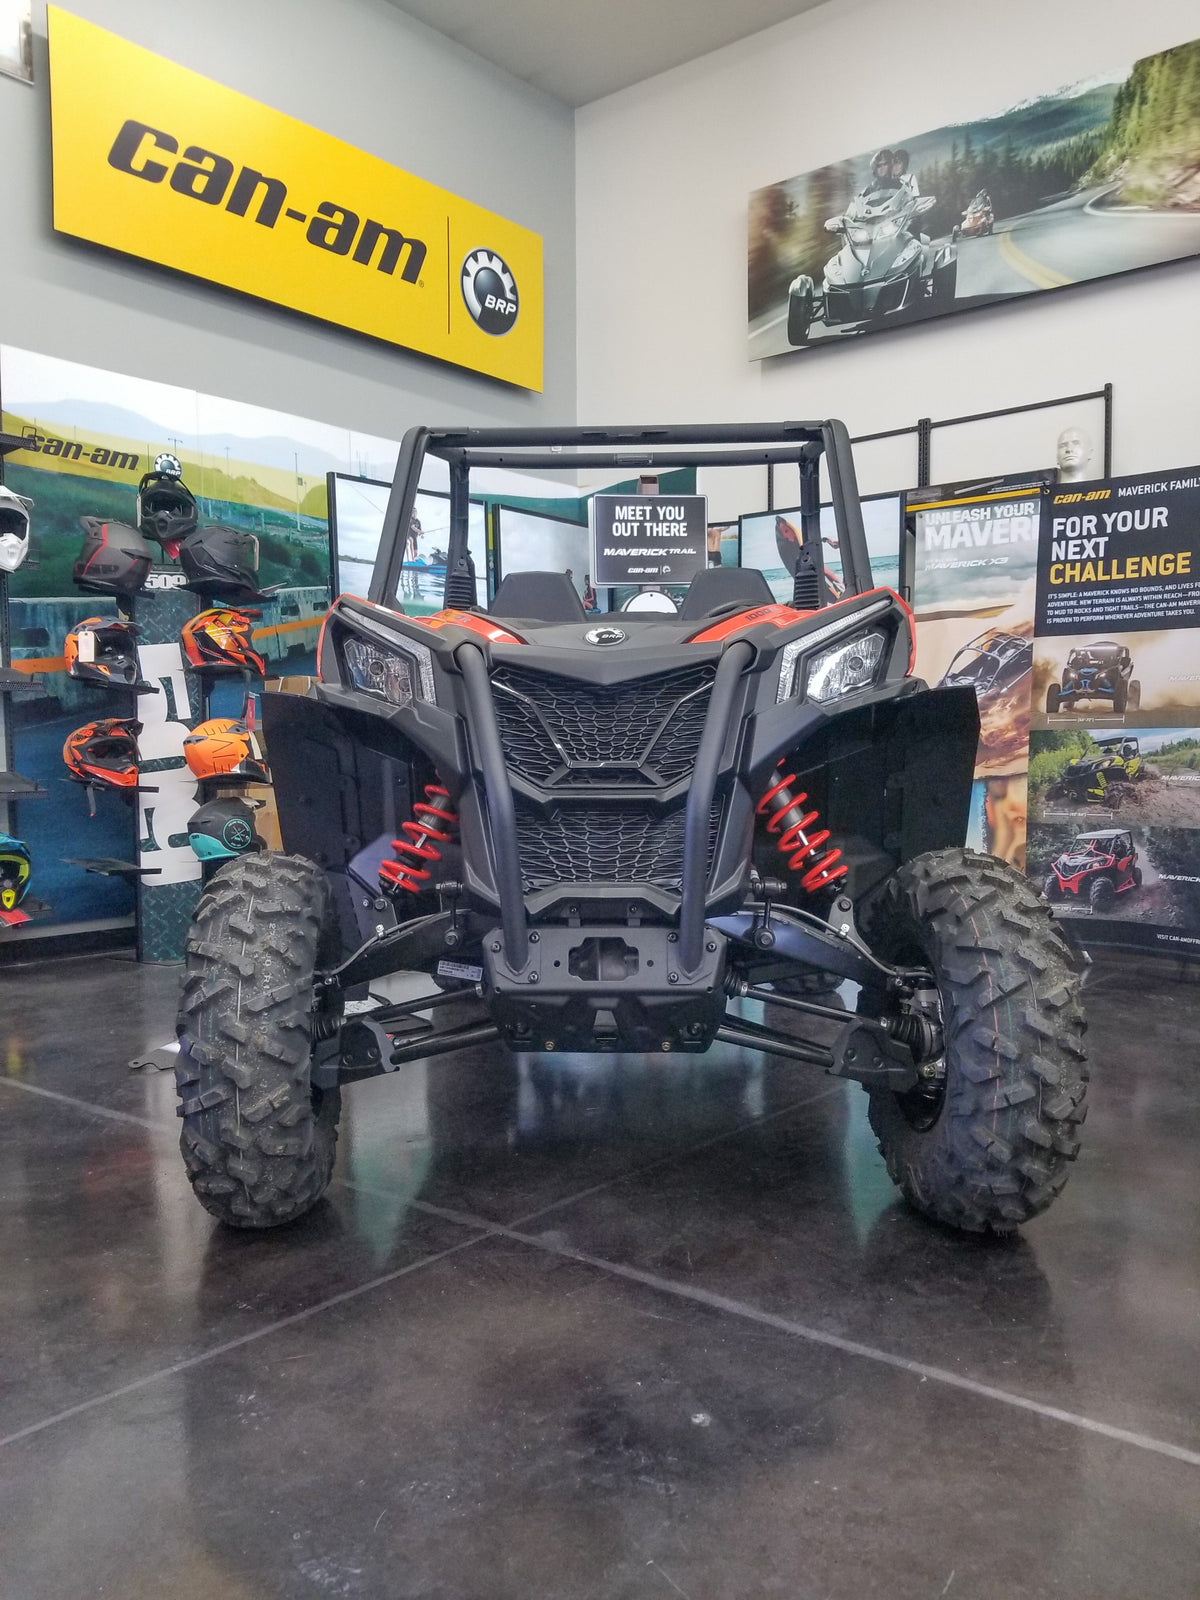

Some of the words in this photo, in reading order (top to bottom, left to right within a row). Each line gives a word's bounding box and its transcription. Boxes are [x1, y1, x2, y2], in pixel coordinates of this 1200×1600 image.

[107, 119, 428, 285] can-am
[484, 293, 517, 315] BRP
[1053, 489, 1111, 505] can-am
[1118, 481, 1168, 498] MAVERICK
[615, 506, 652, 521] MEET
[657, 506, 685, 521] YOU
[925, 507, 991, 526] UNLEASH
[994, 502, 1035, 519] YOUR
[612, 522, 640, 537] OUT
[644, 522, 688, 537] THERE
[1052, 515, 1098, 539] FOR
[1102, 506, 1169, 534] YOUR
[603, 548, 667, 557] MAVERICK
[1051, 536, 1109, 562] NEXT
[1049, 551, 1192, 585] CHALLENGE
[144, 574, 188, 590] 509
[1105, 613, 1133, 621] WHEREVER
[1134, 610, 1165, 618] ADVENTURE
